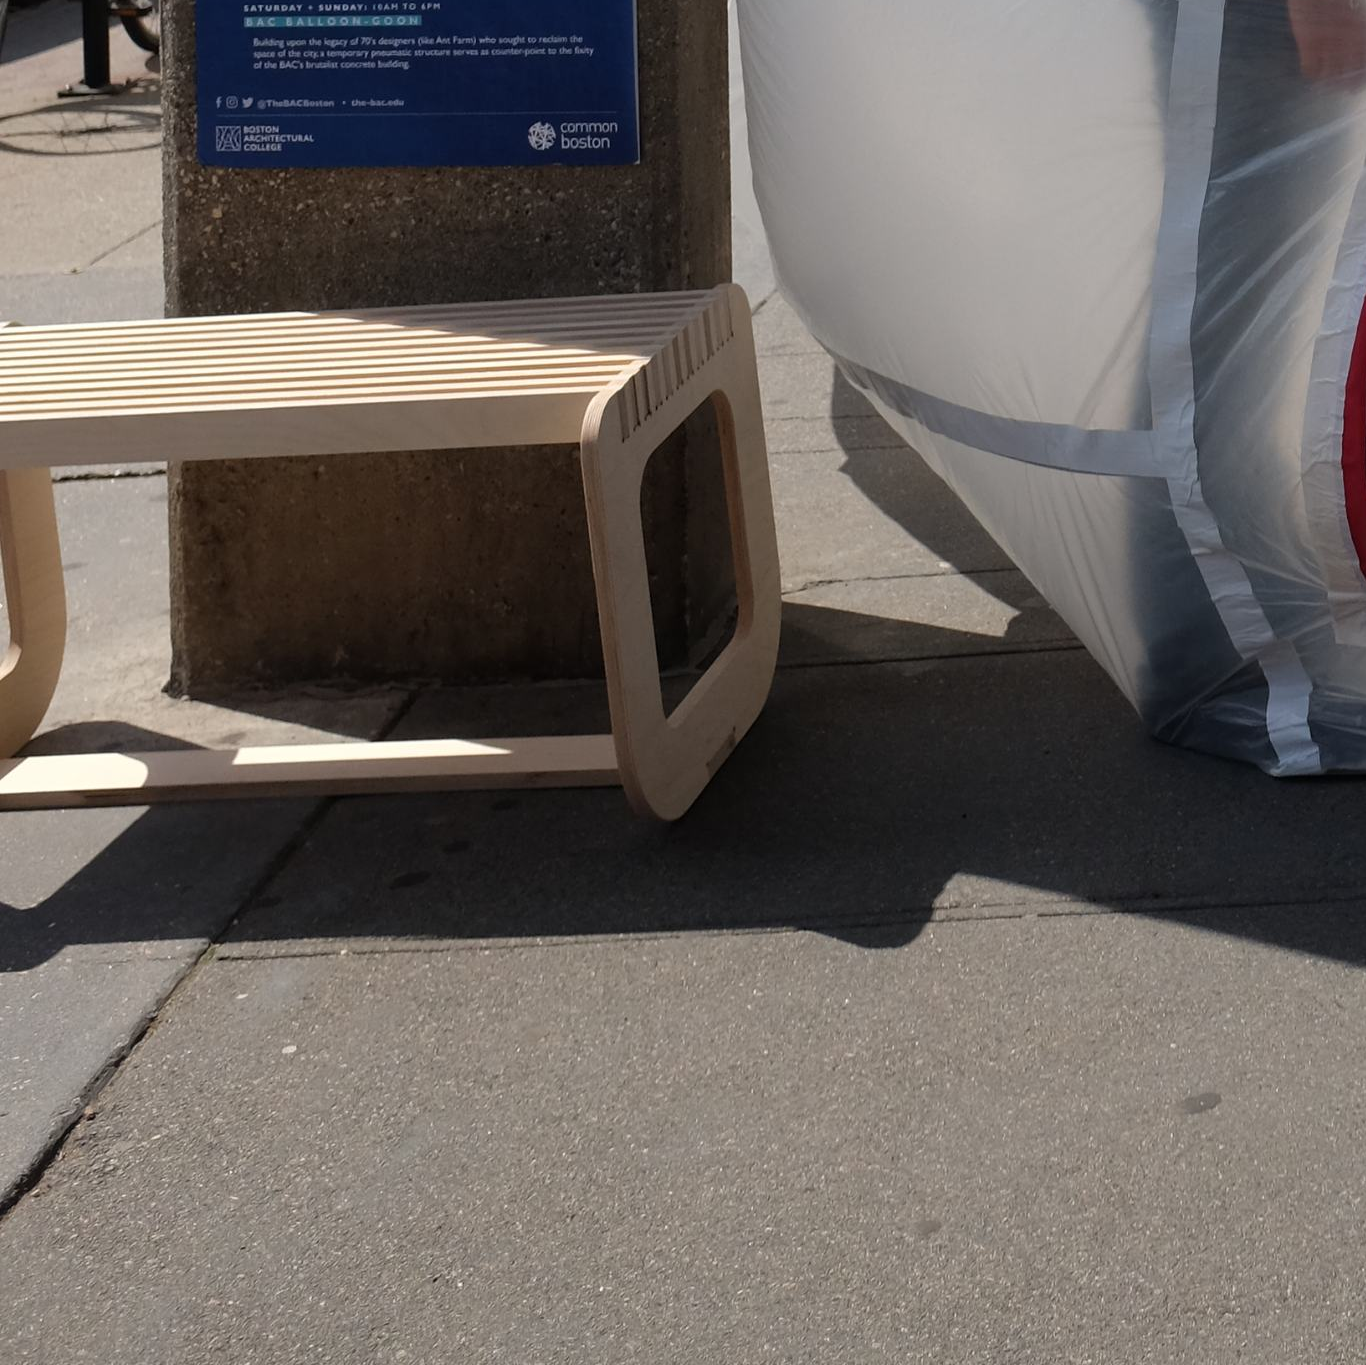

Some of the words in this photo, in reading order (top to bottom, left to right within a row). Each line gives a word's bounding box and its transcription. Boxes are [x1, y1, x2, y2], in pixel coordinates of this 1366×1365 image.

[243, 4, 302, 12] SATURDAY
[318, 3, 367, 11] SUNDAY:
[402, 2, 416, 10] TO
[421, 2, 440, 10] 6PM
[246, 18, 276, 26] BAC
[286, 17, 419, 26] BALLOON-GOON
[243, 125, 279, 134] BOSTON
[560, 123, 618, 134] common
[243, 133, 314, 143] ARCHITECTURAL
[560, 135, 610, 149] boston
[243, 143, 282, 152] COLLEGE
